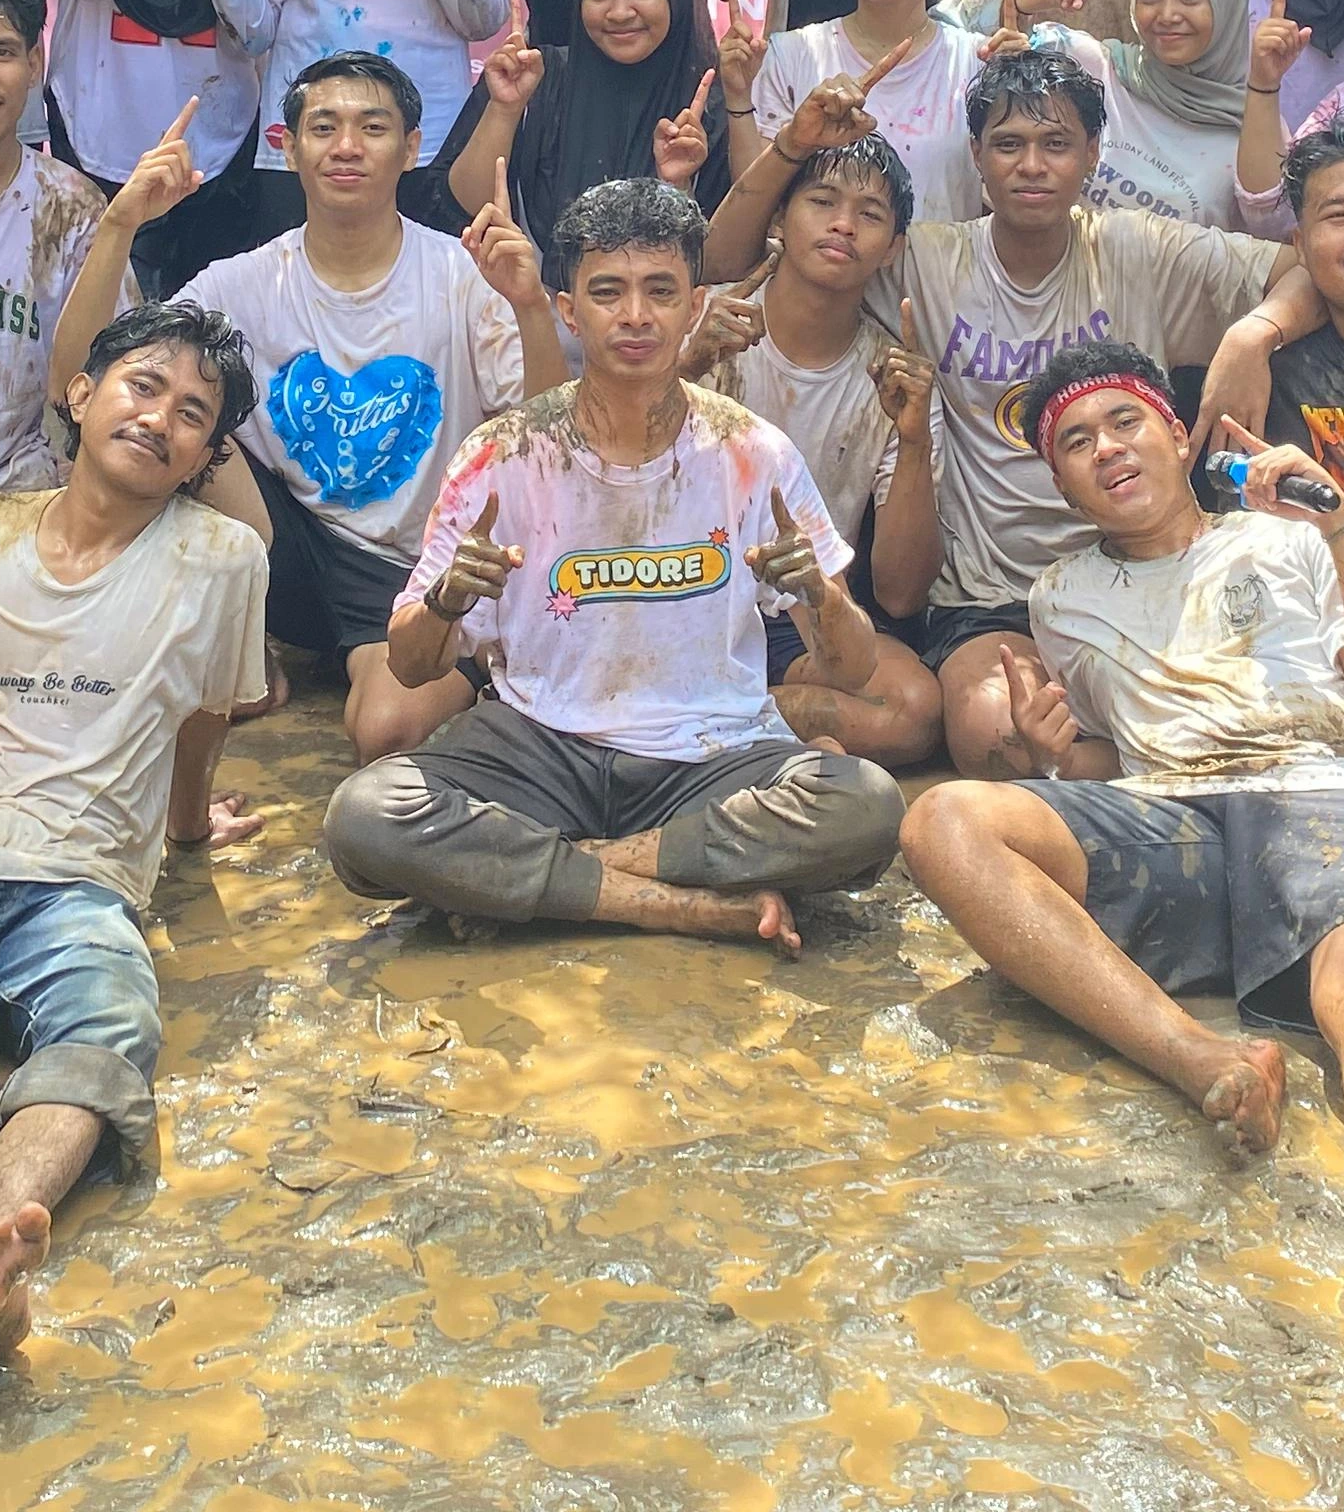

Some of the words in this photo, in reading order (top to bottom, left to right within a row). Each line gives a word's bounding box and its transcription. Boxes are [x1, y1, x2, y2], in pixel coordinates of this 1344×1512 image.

[1143, 153, 1169, 174] LAND
[575, 553, 703, 589] TIDORE
[43, 672, 65, 690] Be
[71, 675, 116, 696] Better
